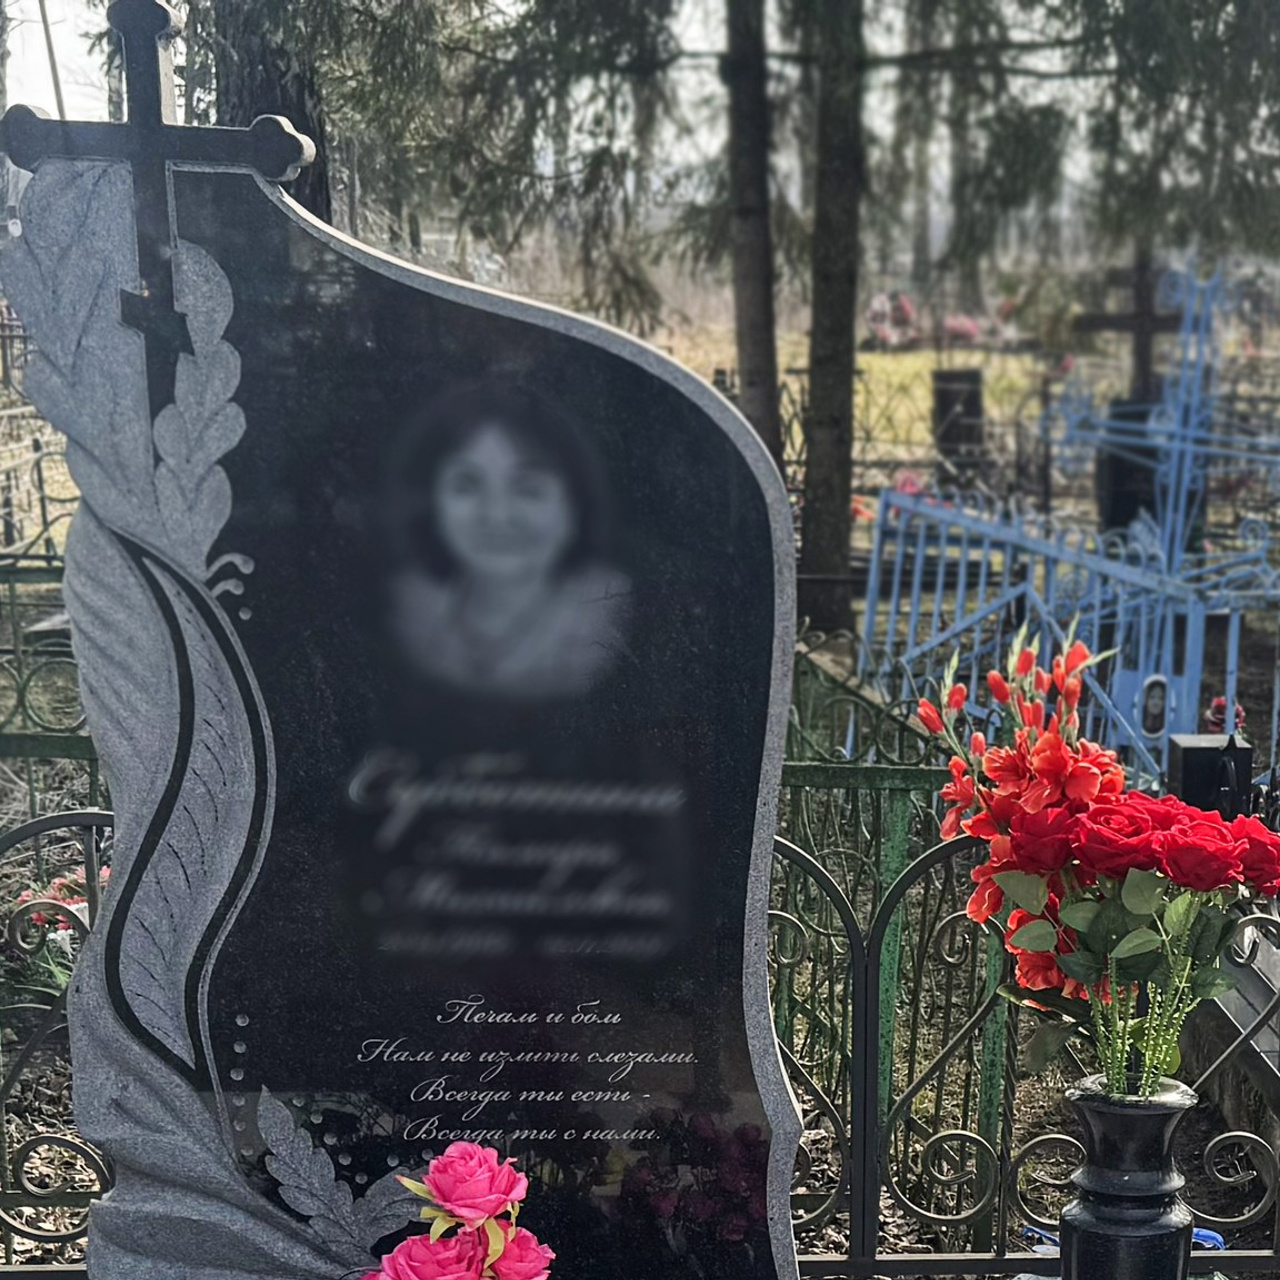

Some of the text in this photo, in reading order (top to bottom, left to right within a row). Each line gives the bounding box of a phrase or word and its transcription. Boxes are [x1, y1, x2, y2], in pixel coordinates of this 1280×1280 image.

[436, 993, 623, 1025] Печаль и боль
[357, 1036, 699, 1084] Нам не излить слезами.
[410, 1074, 512, 1122] Всегда
[519, 1089, 566, 1102] ты
[570, 1089, 632, 1102] есть
[403, 1113, 661, 1144] Всегда ты с нами.
